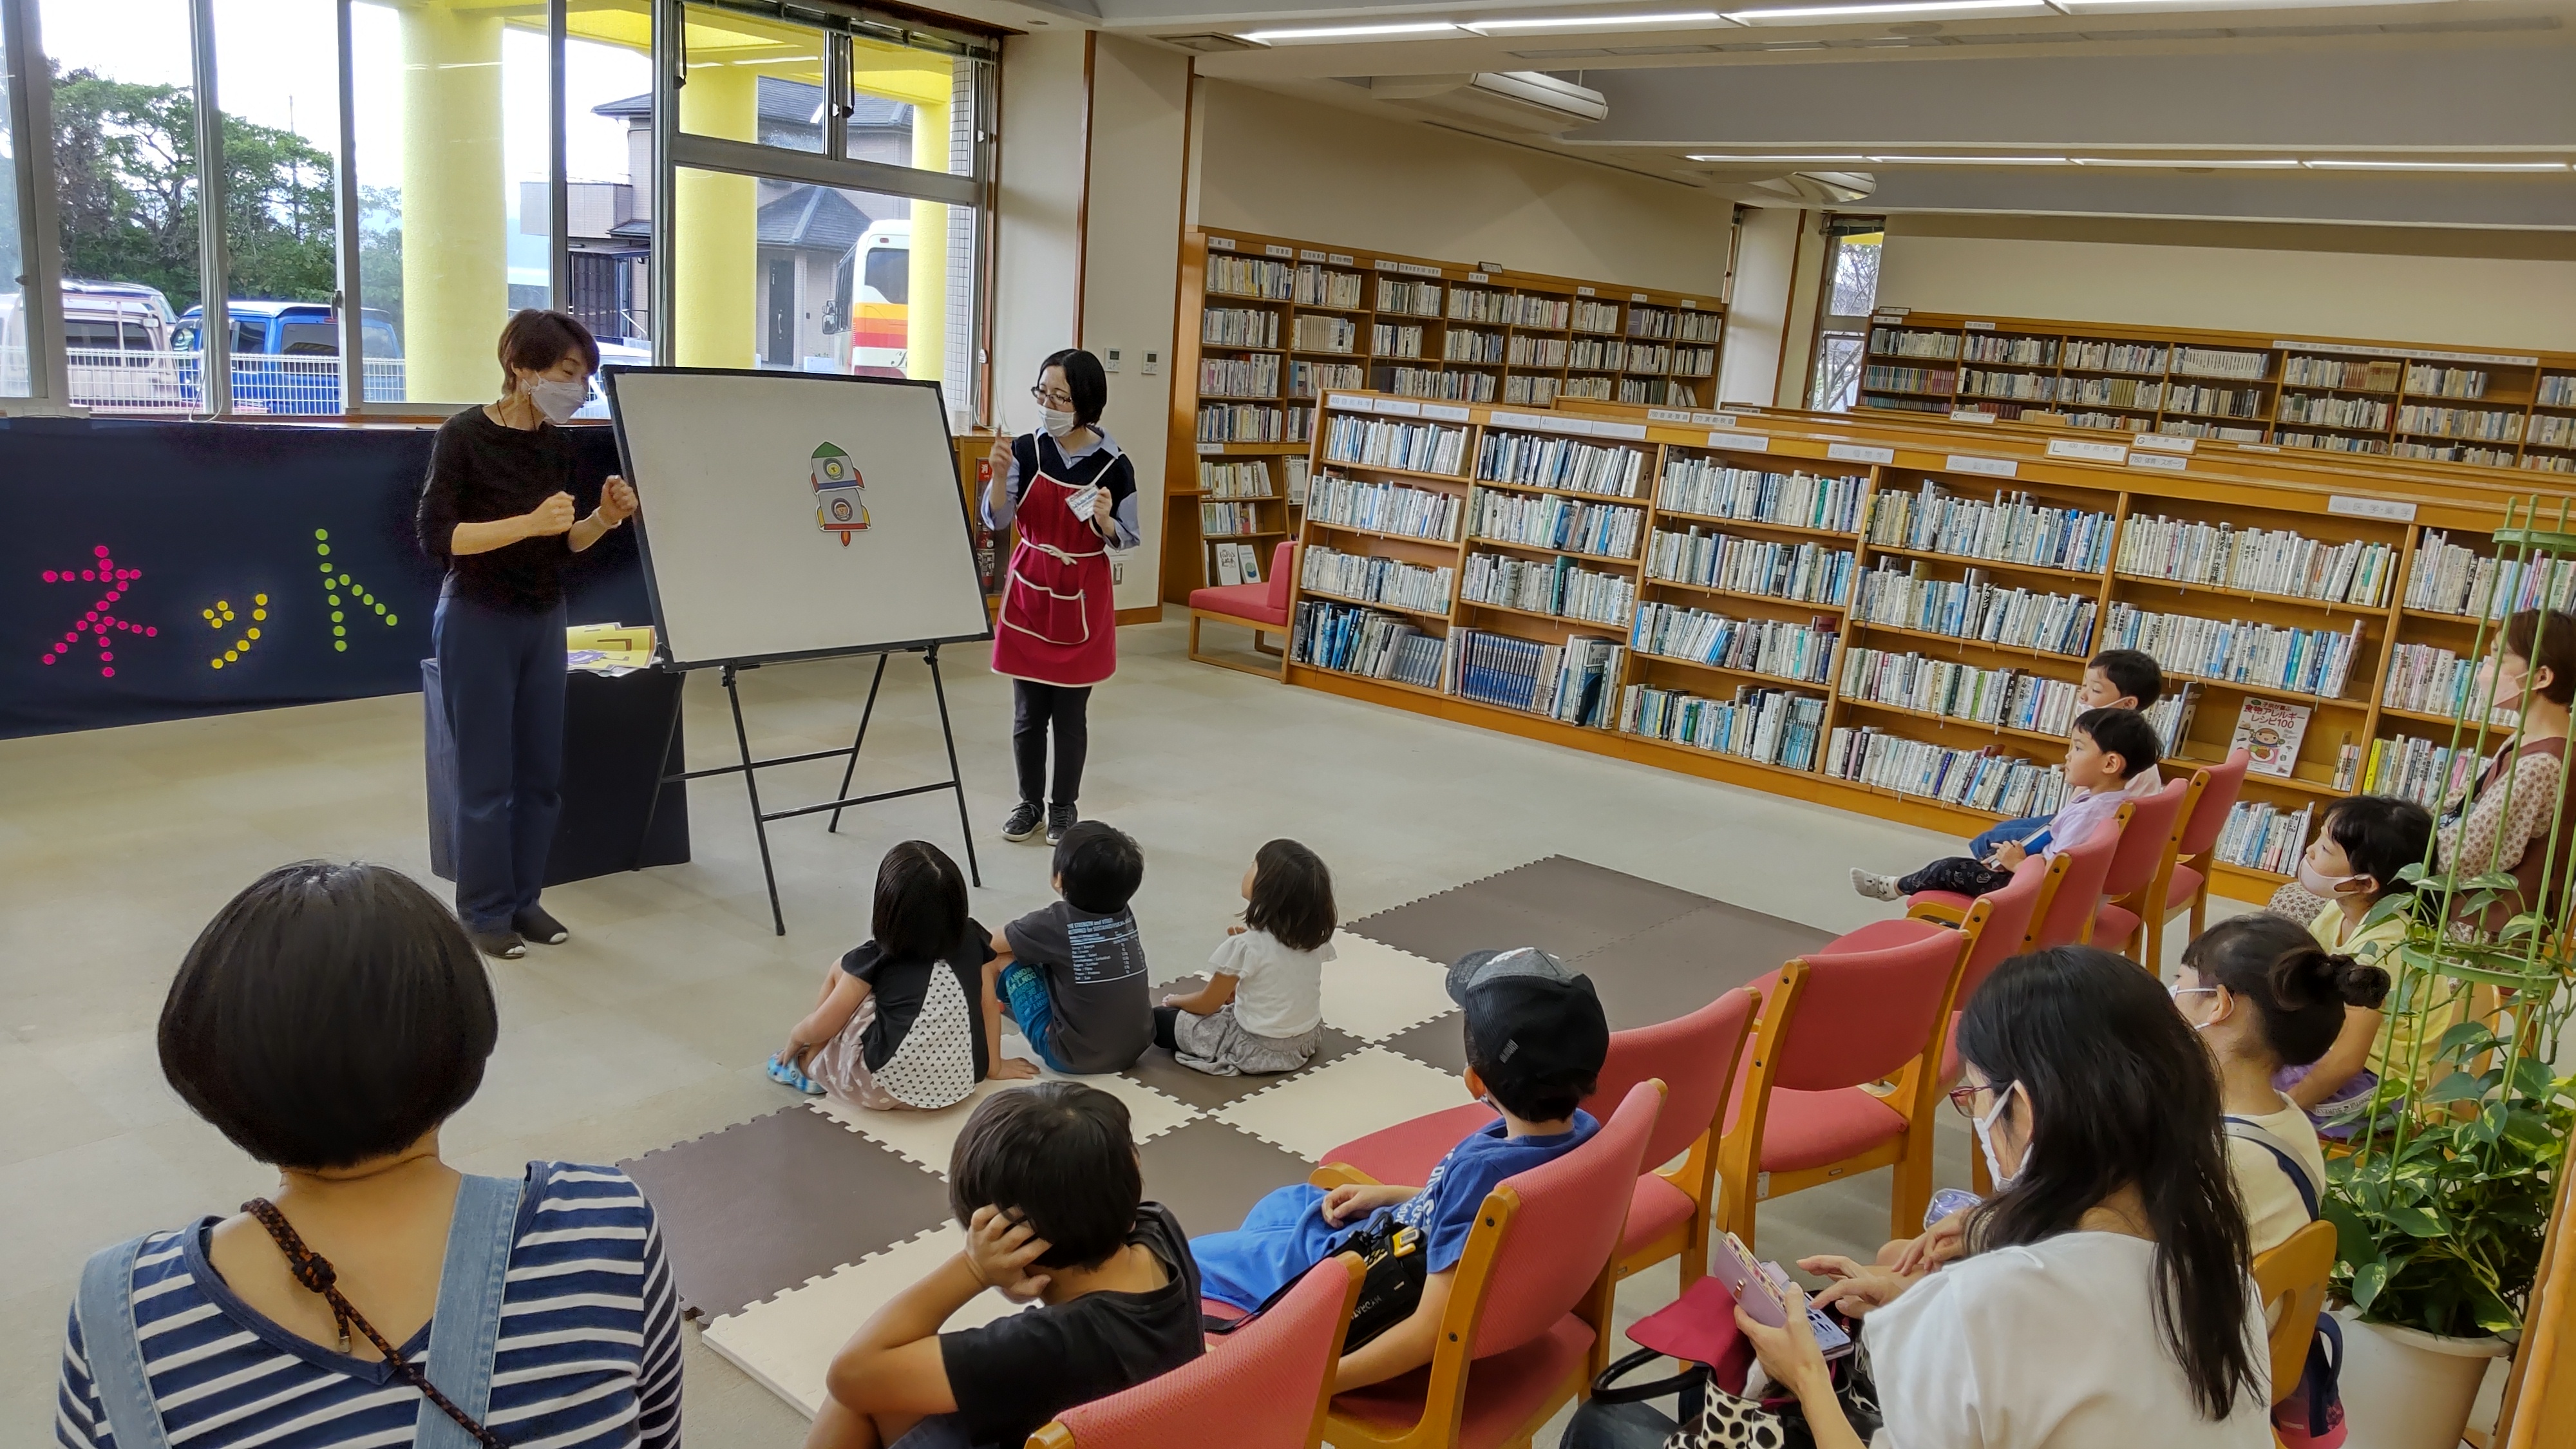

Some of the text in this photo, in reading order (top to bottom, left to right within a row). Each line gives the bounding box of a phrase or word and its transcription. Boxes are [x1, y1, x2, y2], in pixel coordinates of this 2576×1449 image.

[2052, 443, 2060, 453] L
[2130, 455, 2142, 464] 780
[43, 528, 399, 677] ネット
[2244, 704, 2306, 720] 食物アレルギー
[2262, 701, 2291, 712] 子供が喜ぶ
[2251, 714, 2295, 728] レシピ100
